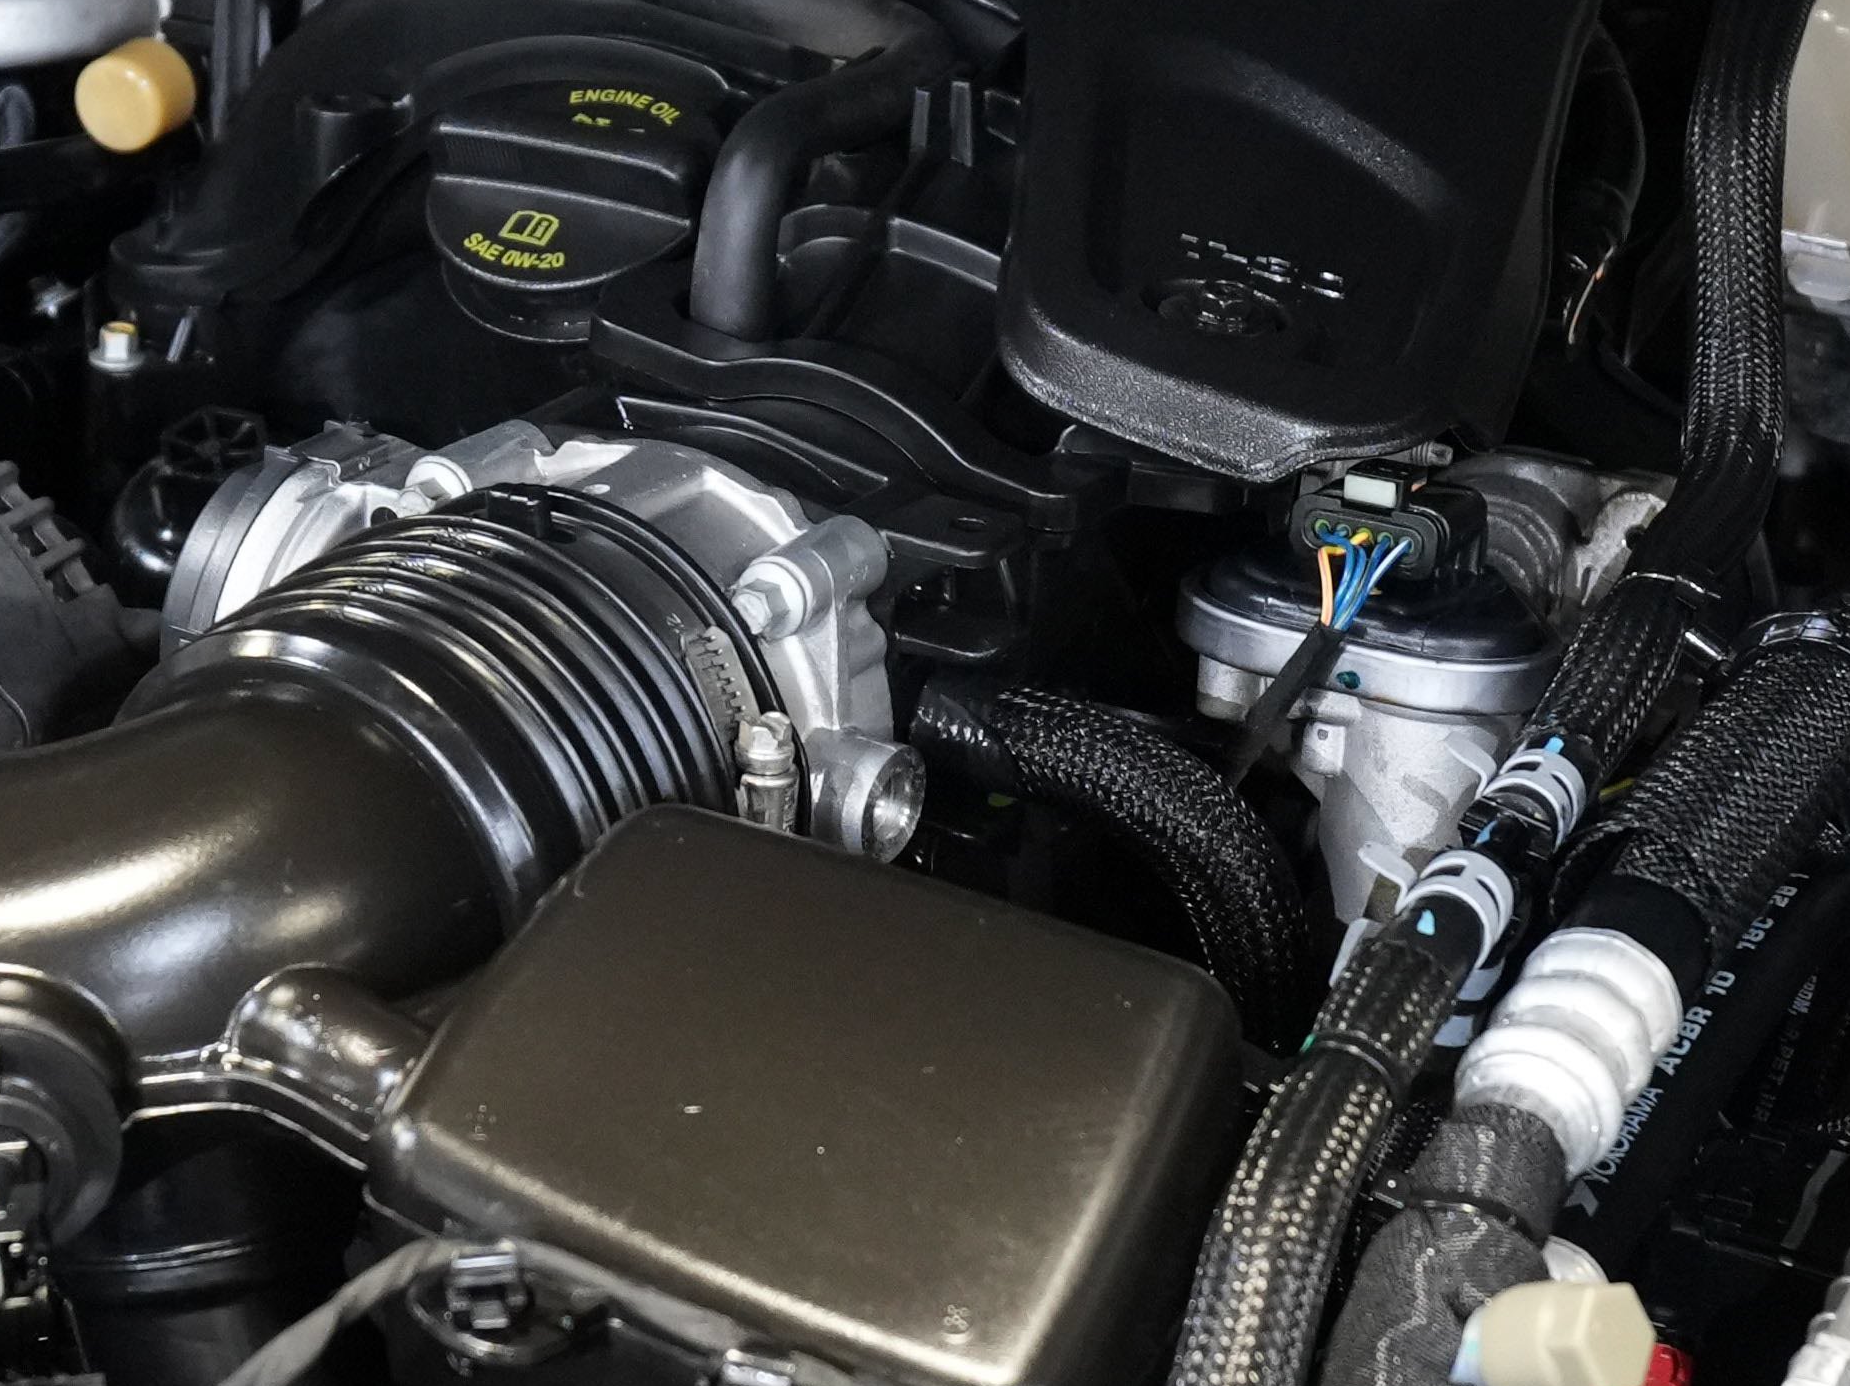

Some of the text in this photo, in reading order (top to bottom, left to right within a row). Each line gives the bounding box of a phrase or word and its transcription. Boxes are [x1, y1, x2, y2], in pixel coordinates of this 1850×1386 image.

[569, 88, 682, 125] ENGINE OIL
[464, 232, 565, 269] SAE 0W-20
[1582, 1086, 1664, 1183] YOKOHAMA
[1656, 1006, 1713, 1076] ACBR
